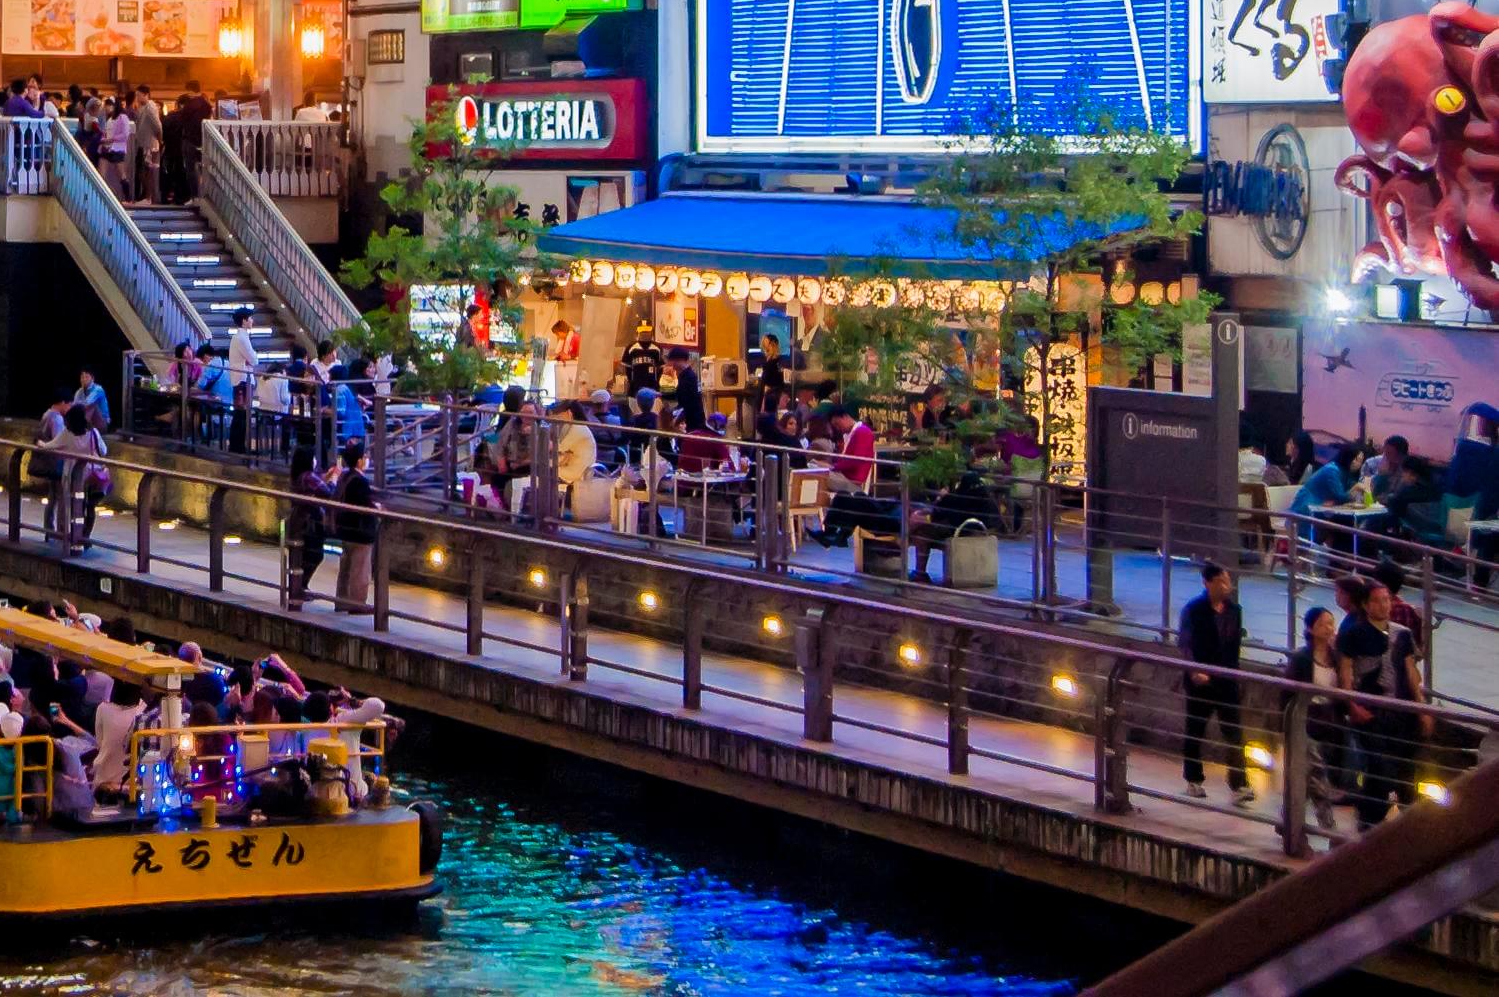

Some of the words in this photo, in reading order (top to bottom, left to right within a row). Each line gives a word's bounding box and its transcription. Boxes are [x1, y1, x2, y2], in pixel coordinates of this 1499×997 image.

[482, 98, 601, 141] LOTTERIA
[1139, 420, 1199, 439] information
[131, 832, 306, 877] えちぜん
